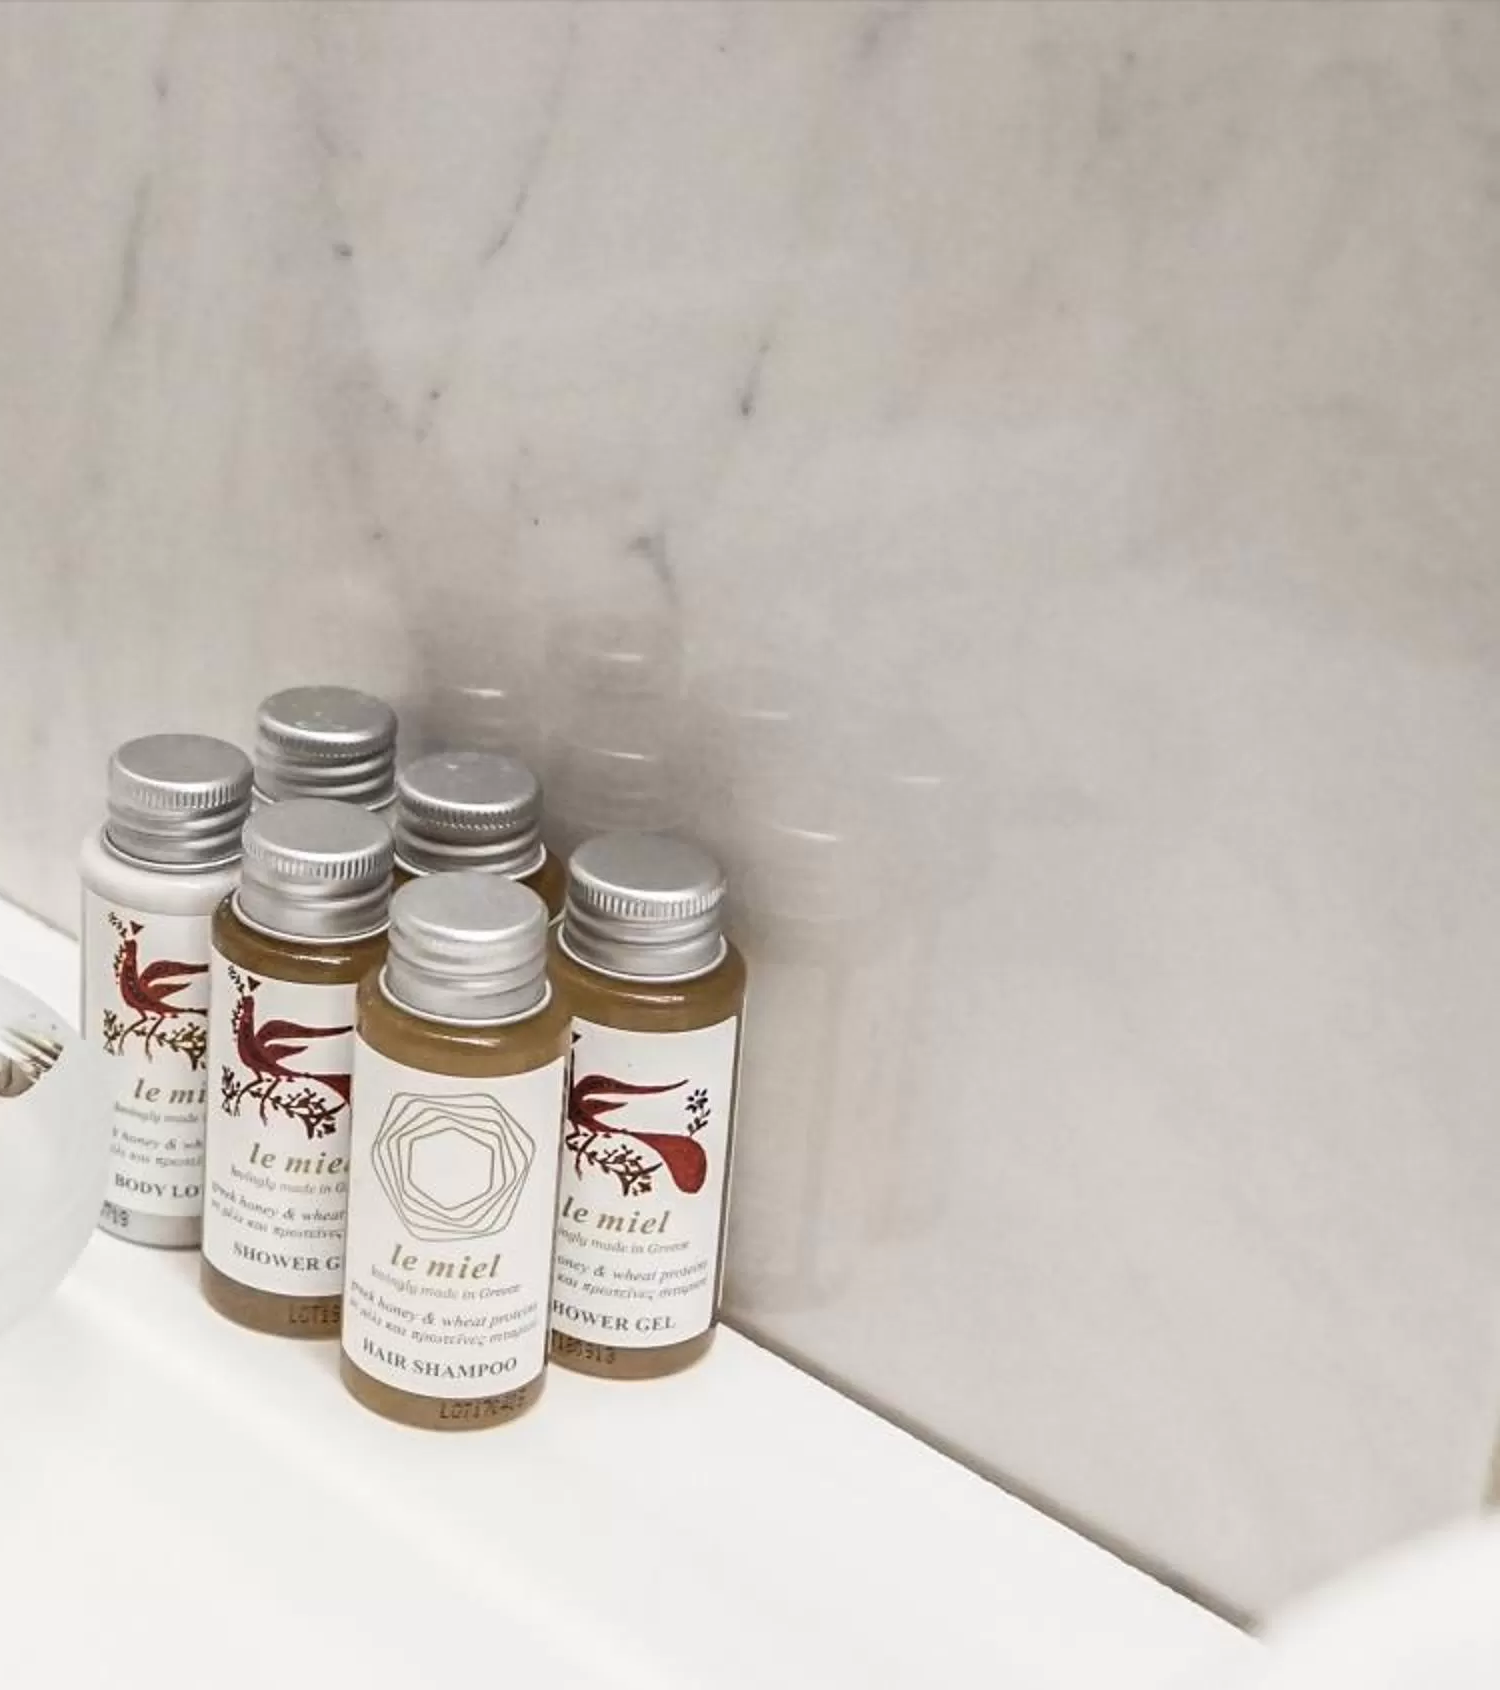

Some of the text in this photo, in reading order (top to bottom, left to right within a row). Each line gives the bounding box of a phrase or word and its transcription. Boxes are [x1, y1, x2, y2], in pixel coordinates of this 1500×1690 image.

[134, 1078, 208, 1104] le mi
[250, 1142, 276, 1168] le
[115, 1172, 165, 1197] BODY
[239, 1195, 276, 1218] honey
[282, 1208, 296, 1221] &
[562, 1195, 671, 1235] le miel
[232, 1241, 319, 1272] SHOWER
[391, 1244, 501, 1279] le miel
[557, 1255, 590, 1273] oney
[594, 1266, 605, 1277] &
[613, 1268, 657, 1281] wheat
[377, 1294, 416, 1322] honey
[421, 1312, 436, 1325] &
[442, 1315, 486, 1328] wheat
[552, 1299, 676, 1332] HOWER GEL
[363, 1337, 518, 1379] HAIR SHAMPOO
